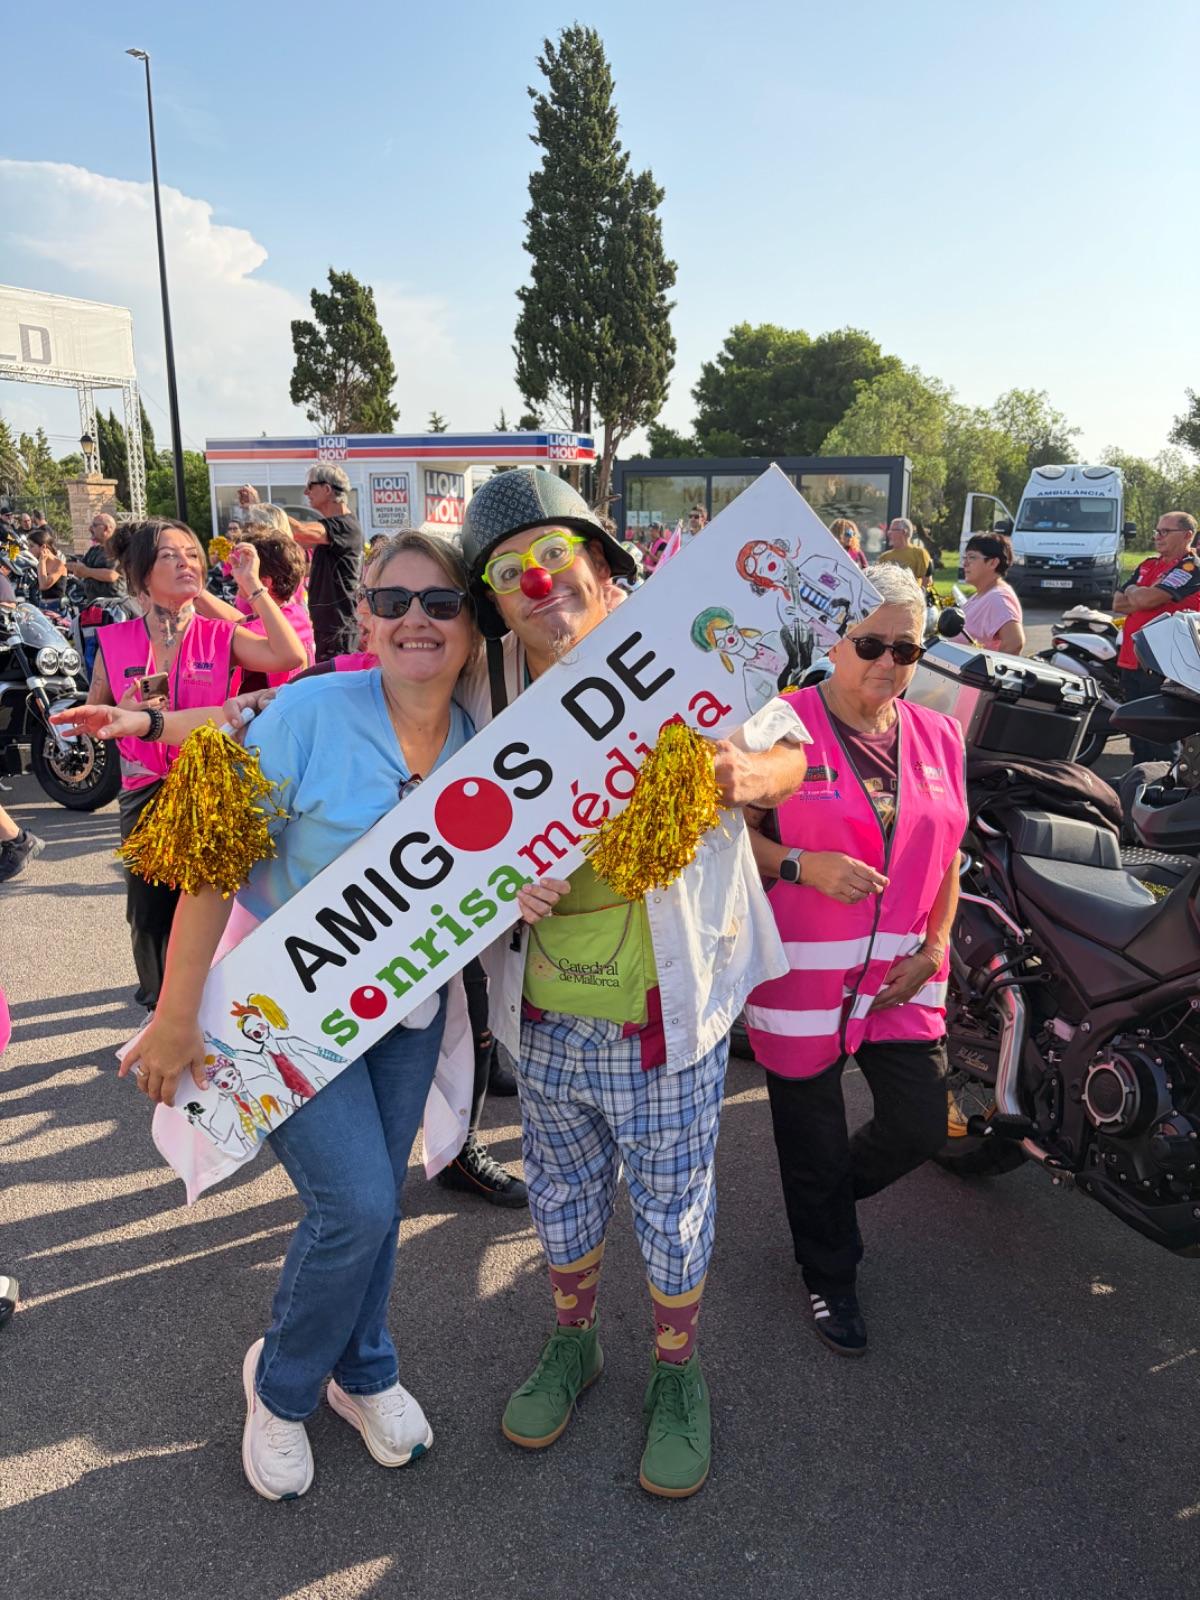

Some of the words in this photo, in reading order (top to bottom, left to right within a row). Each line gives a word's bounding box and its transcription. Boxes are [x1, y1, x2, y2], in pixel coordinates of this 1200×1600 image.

[319, 438, 346, 448] LIQUI
[550, 435, 577, 446] LIQUI
[319, 449, 346, 460] MOLY
[550, 446, 577, 459] MOLY
[375, 479, 406, 490] LIQUI
[426, 471, 464, 498] LIQUI
[375, 491, 407, 503] MOLY
[427, 499, 465, 522] MOLY
[285, 743, 553, 994] AMIGOS
[560, 631, 676, 742] DE
[558, 958, 619, 976] Catedral
[559, 972, 573, 982] de
[574, 974, 621, 987] Mallorca
